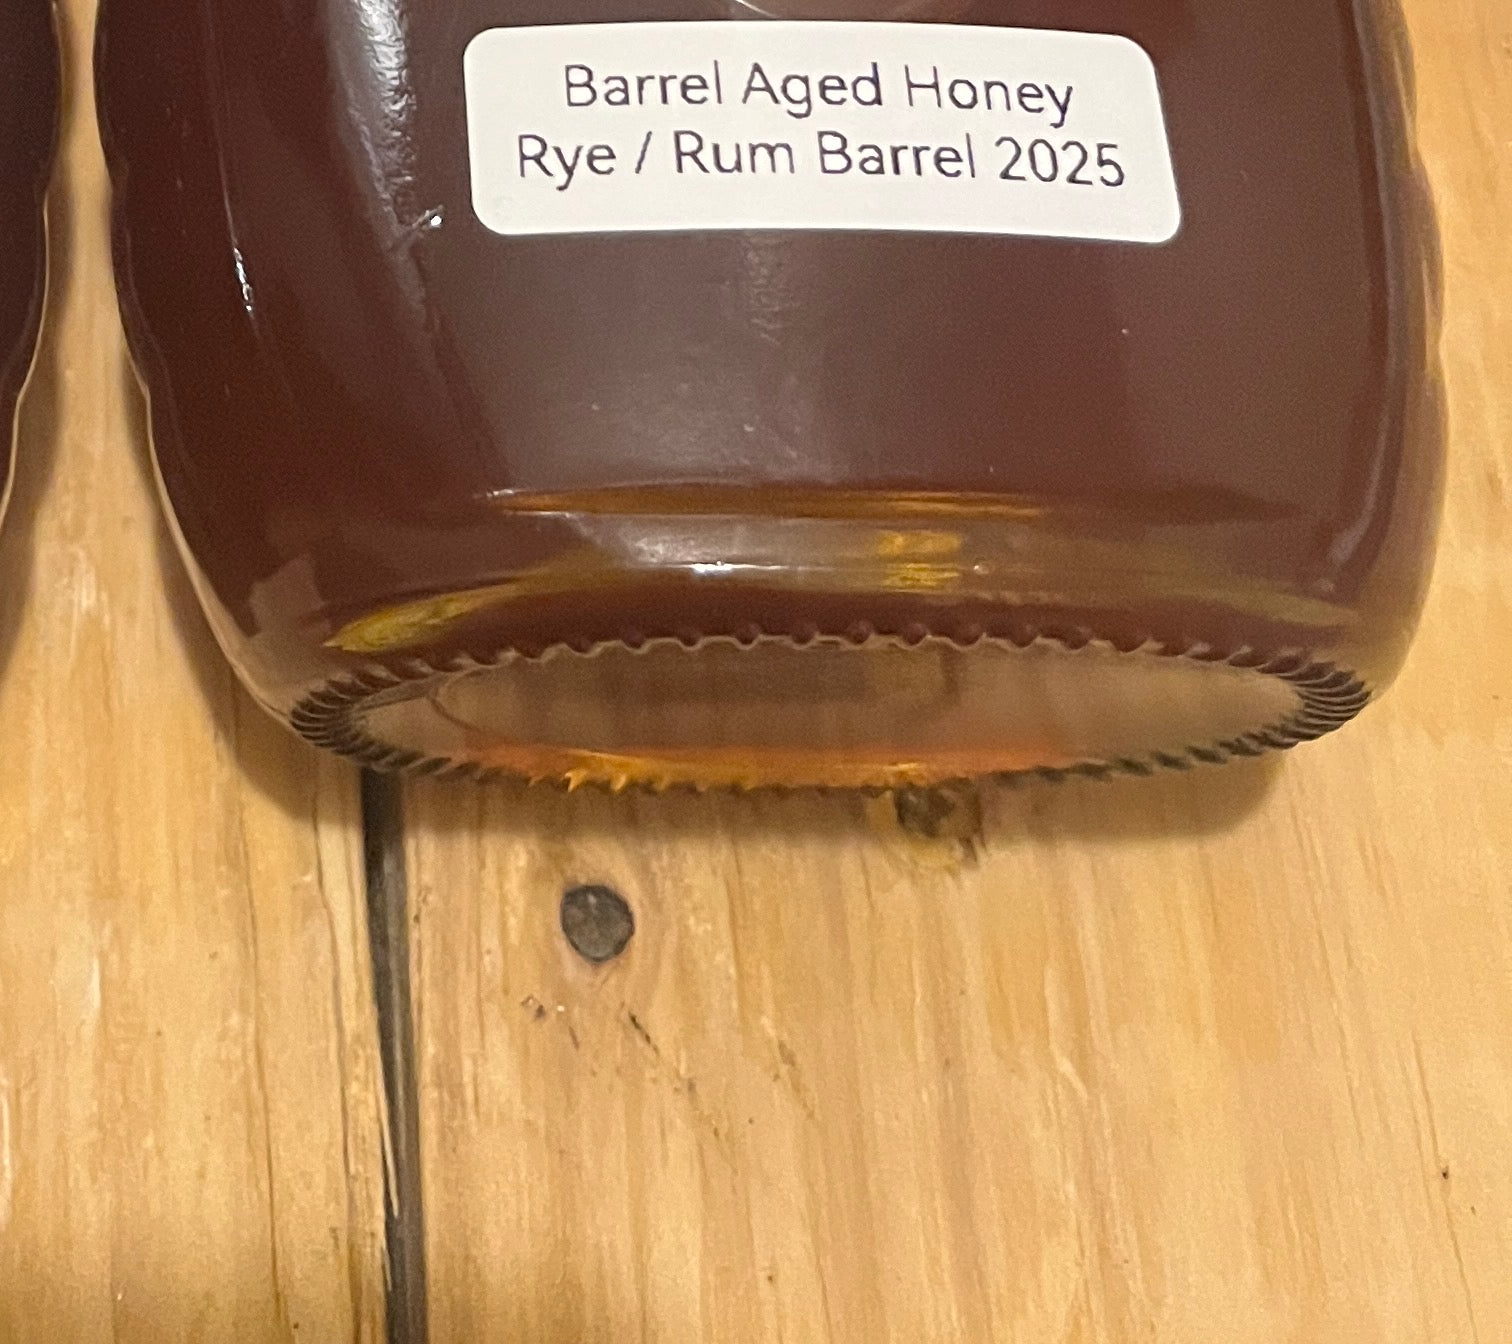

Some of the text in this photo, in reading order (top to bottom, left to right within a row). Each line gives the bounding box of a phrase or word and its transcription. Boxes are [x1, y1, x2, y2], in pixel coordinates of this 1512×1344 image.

[565, 60, 1073, 129] Barrel Aged Honey
[519, 130, 1124, 191] Rye / Rum Barrel 2025
